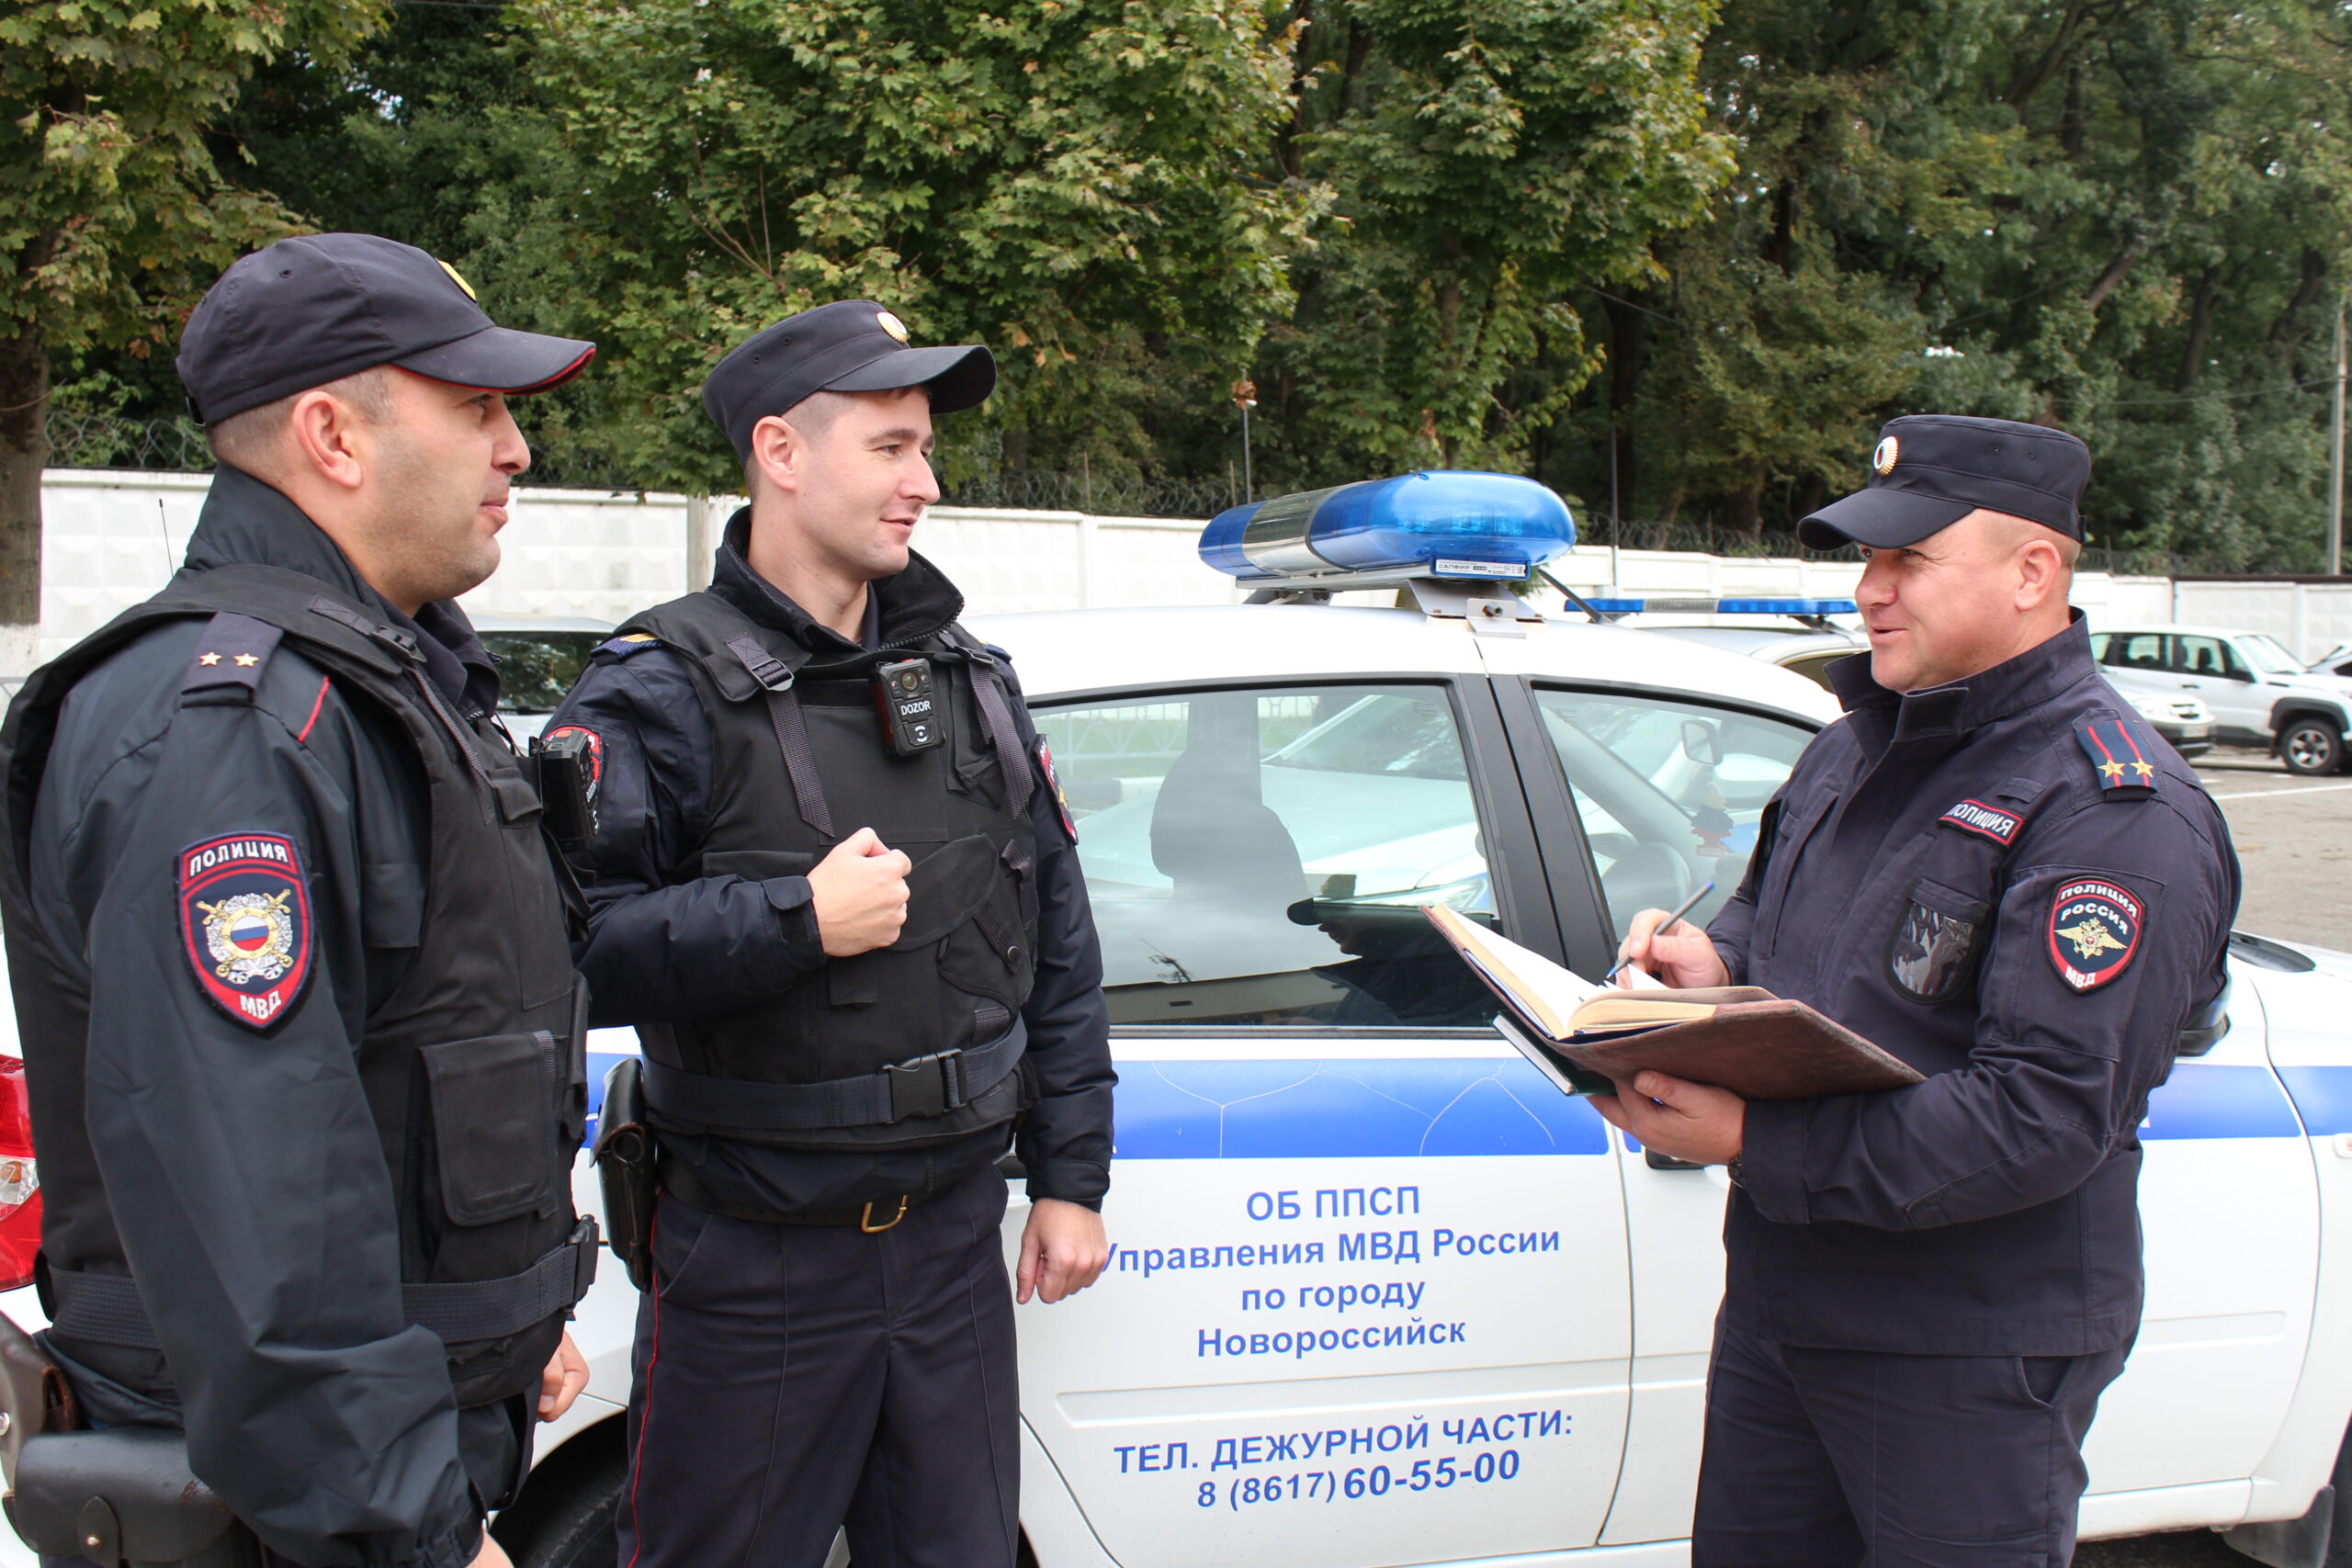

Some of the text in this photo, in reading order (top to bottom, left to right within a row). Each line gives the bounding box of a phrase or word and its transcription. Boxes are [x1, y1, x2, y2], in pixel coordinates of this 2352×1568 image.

[900, 700, 932, 716] DOZOR
[1946, 804, 2016, 837] ПОЛИЦИЯ
[190, 840, 288, 876] ПОЛИЦИЯ
[2060, 884, 2137, 918] ПОЛИЦИЯ
[2061, 903, 2129, 935] РОССИЯ
[2064, 964, 2097, 989] МВД
[239, 990, 282, 1021] МВД
[1246, 1186, 1420, 1222] ОБ ППСП
[1339, 1231, 1421, 1265] МВД
[1433, 1228, 1560, 1258] России
[1242, 1281, 1426, 1314] по городу
[1198, 1316, 1466, 1360] Новороссийск
[1114, 1410, 1573, 1475] ТЕЛ. ДЕЖУРНОЙ ЧАСТИ:
[1197, 1449, 1521, 1513] 8 (8617) 60-55-00
